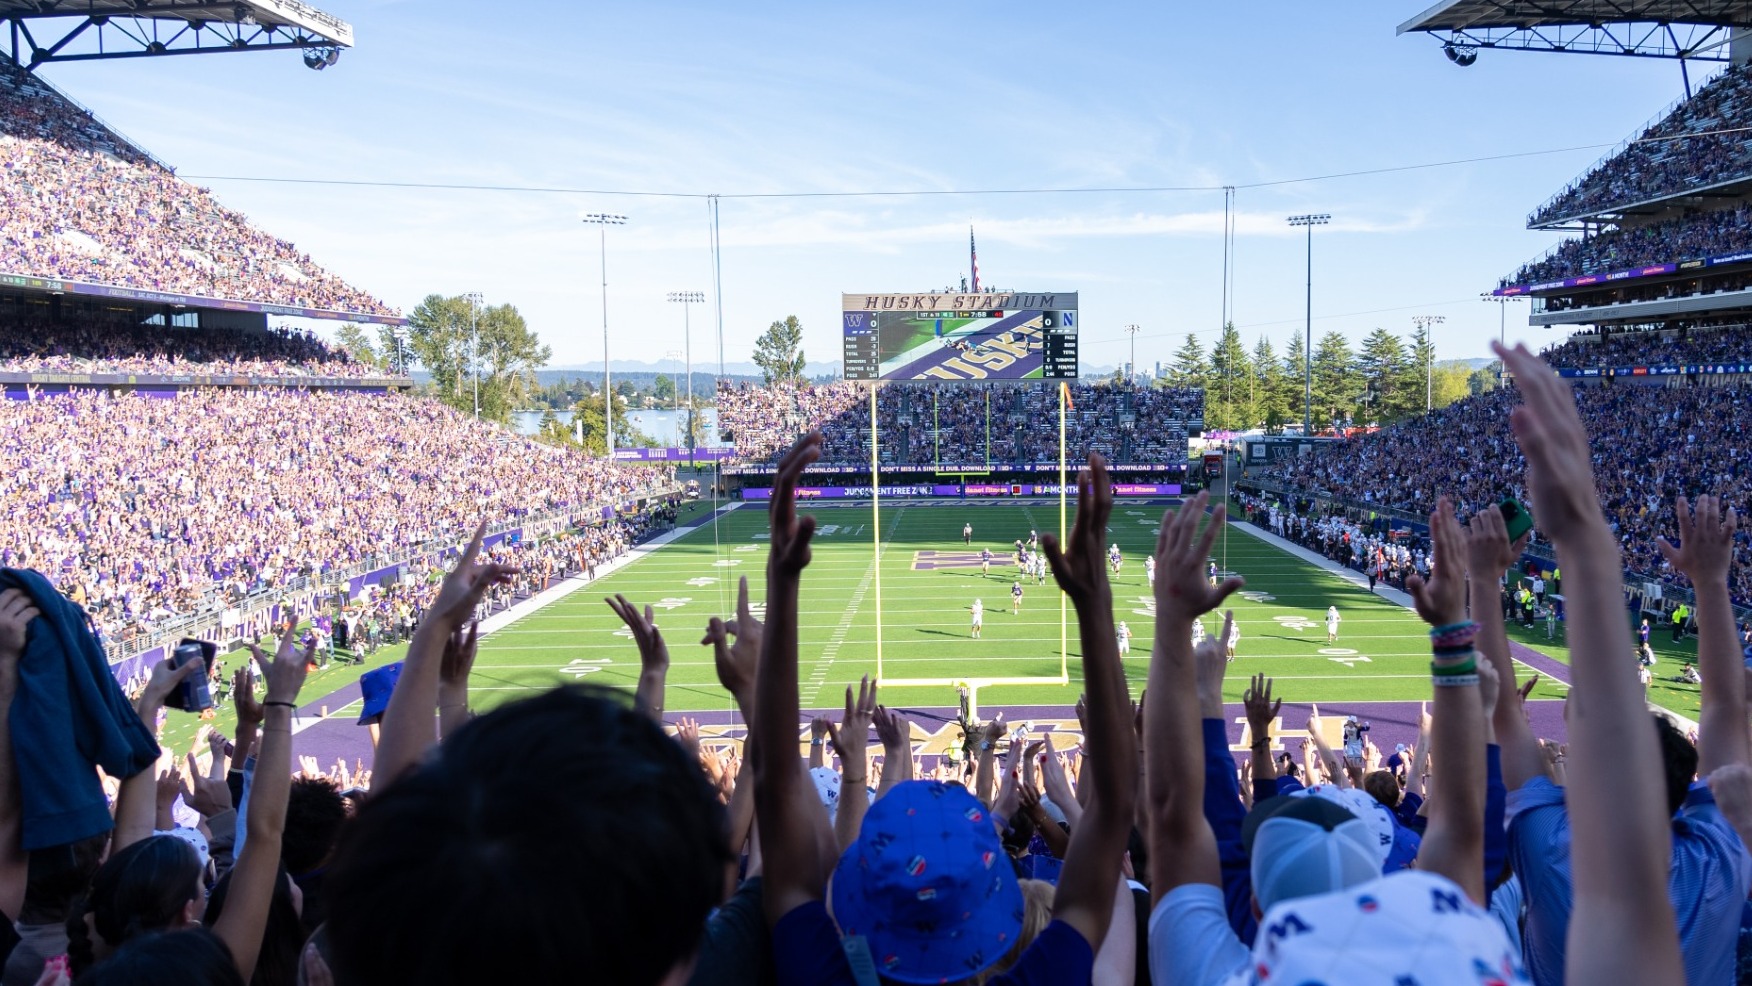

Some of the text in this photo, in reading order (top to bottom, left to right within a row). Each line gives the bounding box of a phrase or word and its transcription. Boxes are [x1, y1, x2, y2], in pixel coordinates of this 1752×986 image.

[46, 281, 62, 289] 7:58
[108, 289, 136, 298] FOOTBALL
[864, 295, 1055, 310] HUSKY STADIUM
[845, 314, 863, 326] W
[1064, 312, 1072, 326] N
[1272, 446, 1293, 460] W
[827, 790, 836, 798] W
